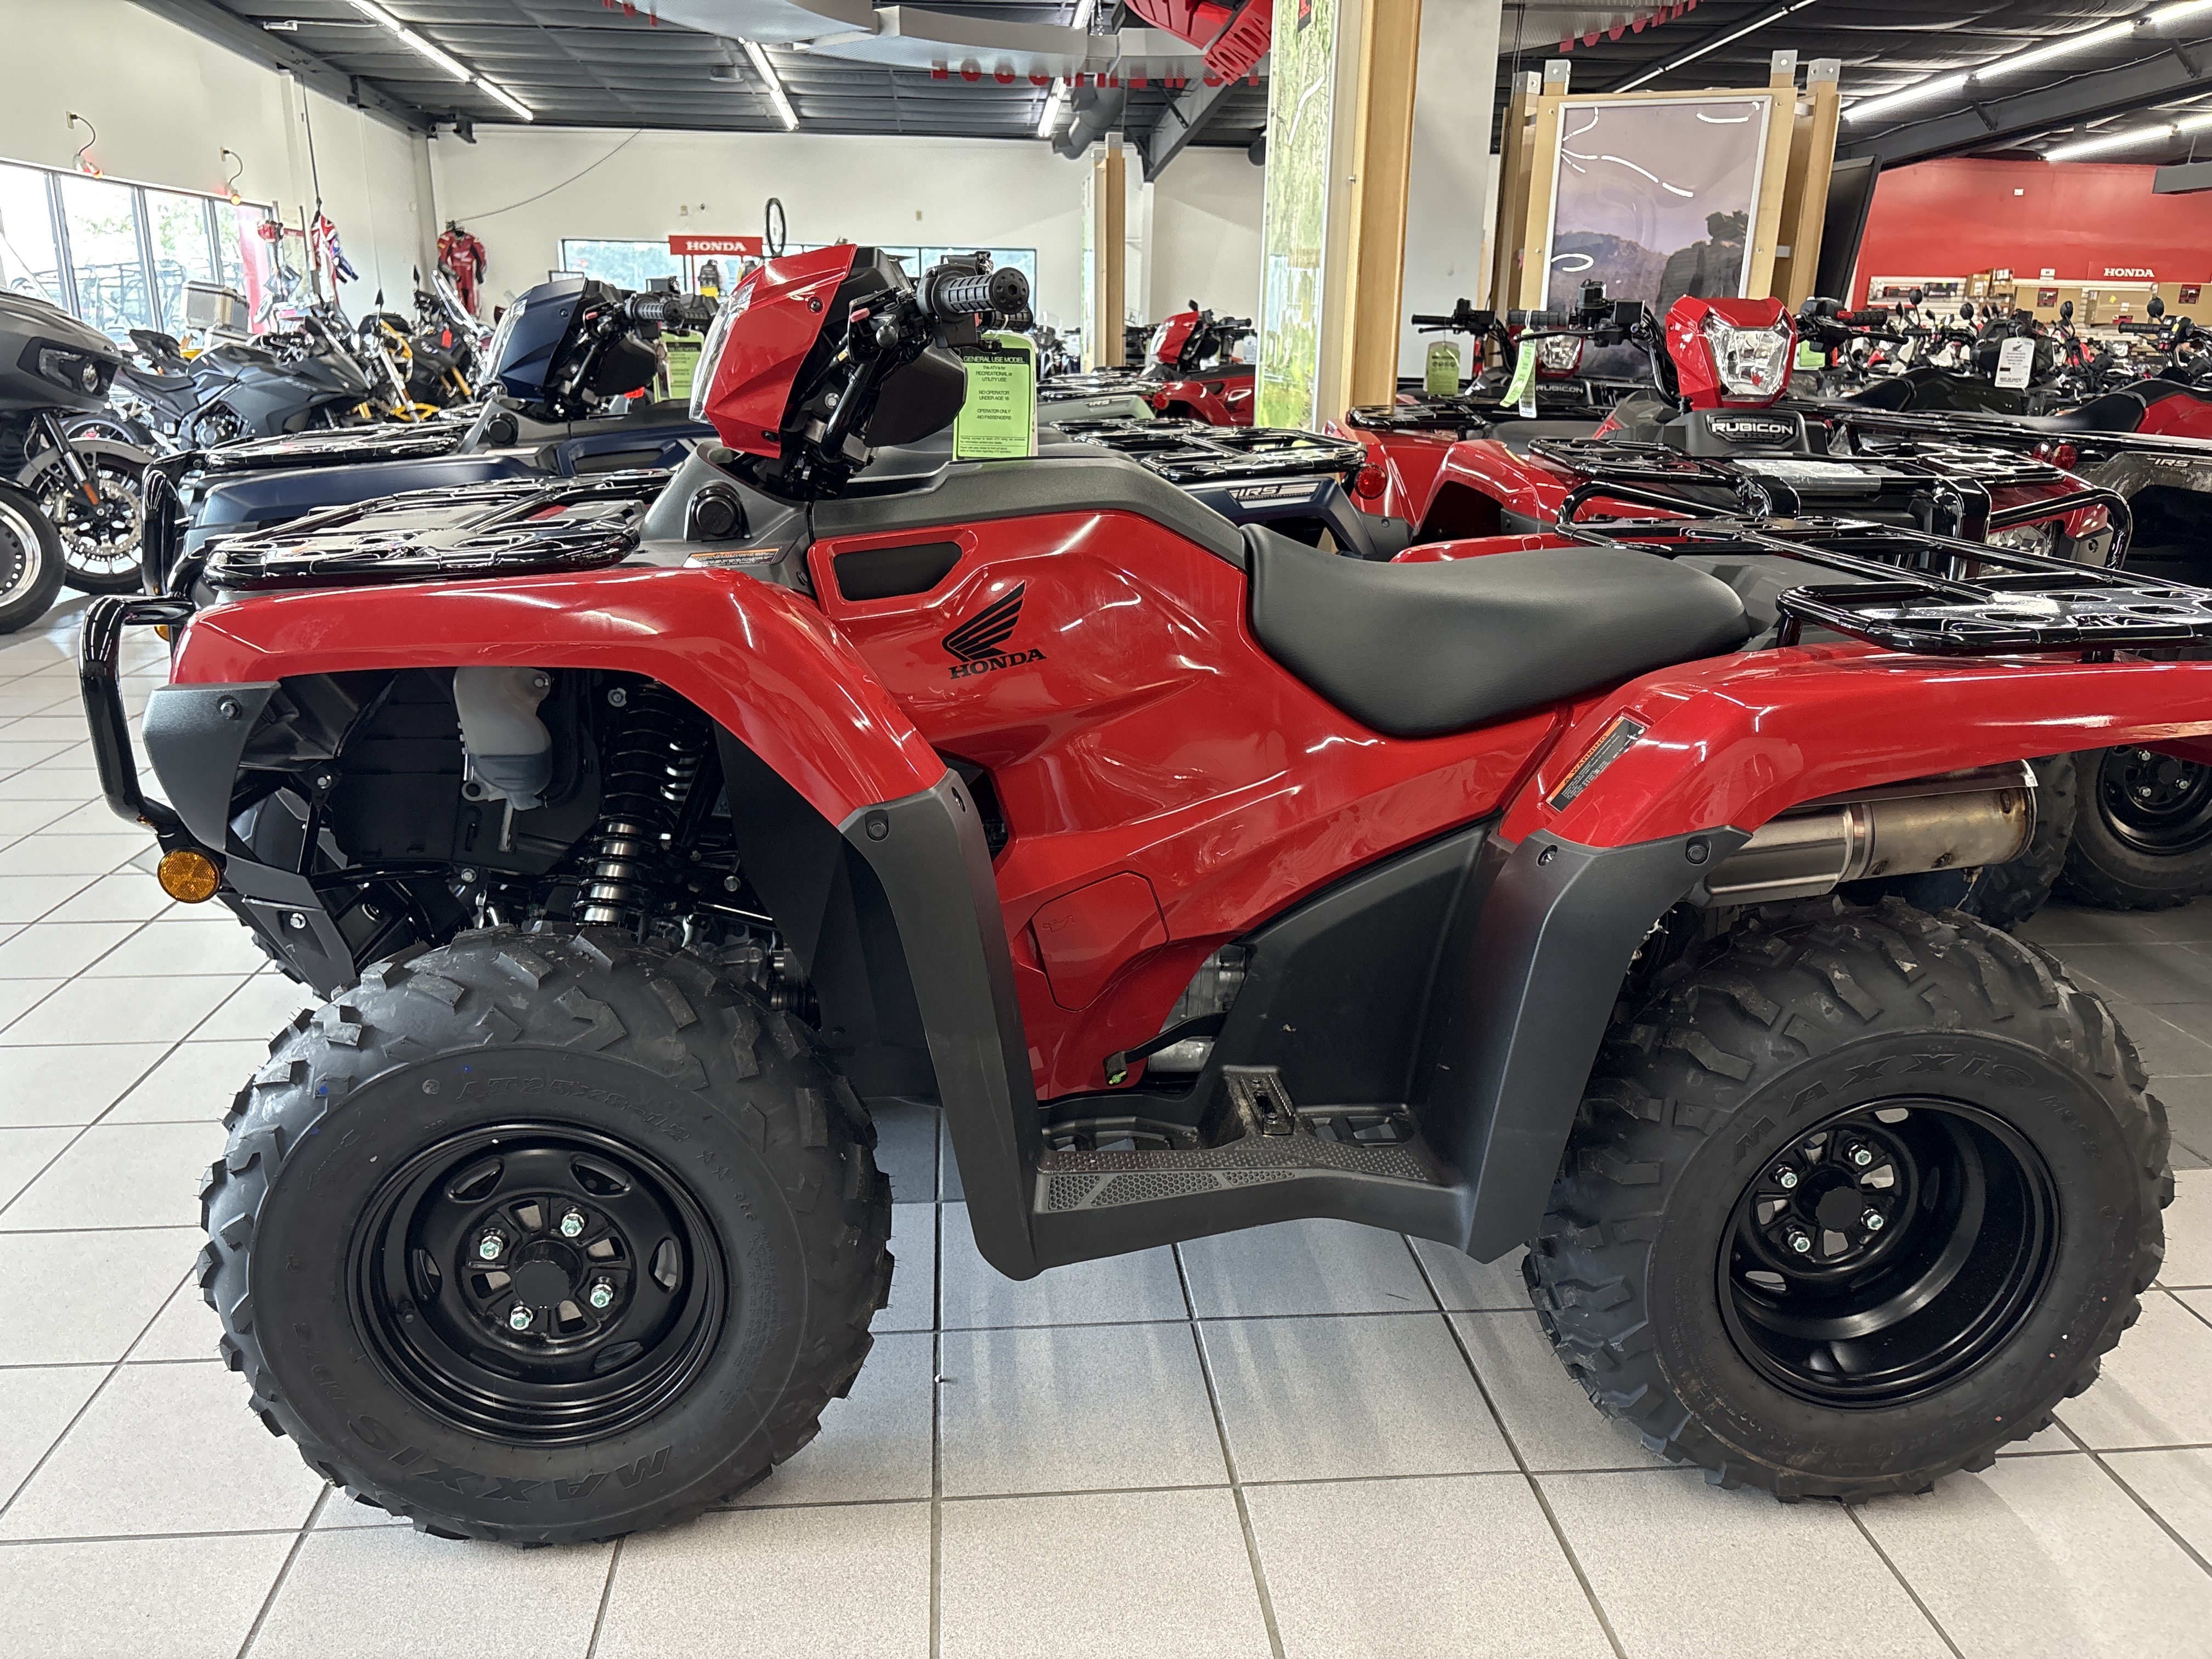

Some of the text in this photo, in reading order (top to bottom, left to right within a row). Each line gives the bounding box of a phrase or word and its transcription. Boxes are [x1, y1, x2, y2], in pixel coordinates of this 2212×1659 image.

[1202, 15, 1271, 86] HONDA
[686, 240, 747, 252] HONDA
[2103, 267, 2155, 278] HONDA
[1536, 385, 1583, 394] RUBICON
[1712, 422, 1793, 435] RUBICON
[2154, 458, 2191, 467] IRS
[1239, 486, 1279, 497] IRS
[949, 648, 1047, 679] HONDA
[1571, 735, 1607, 774] WARNING
[1734, 1053, 2035, 1165] MAXXIS
[346, 1415, 673, 1503] MAXXIS
